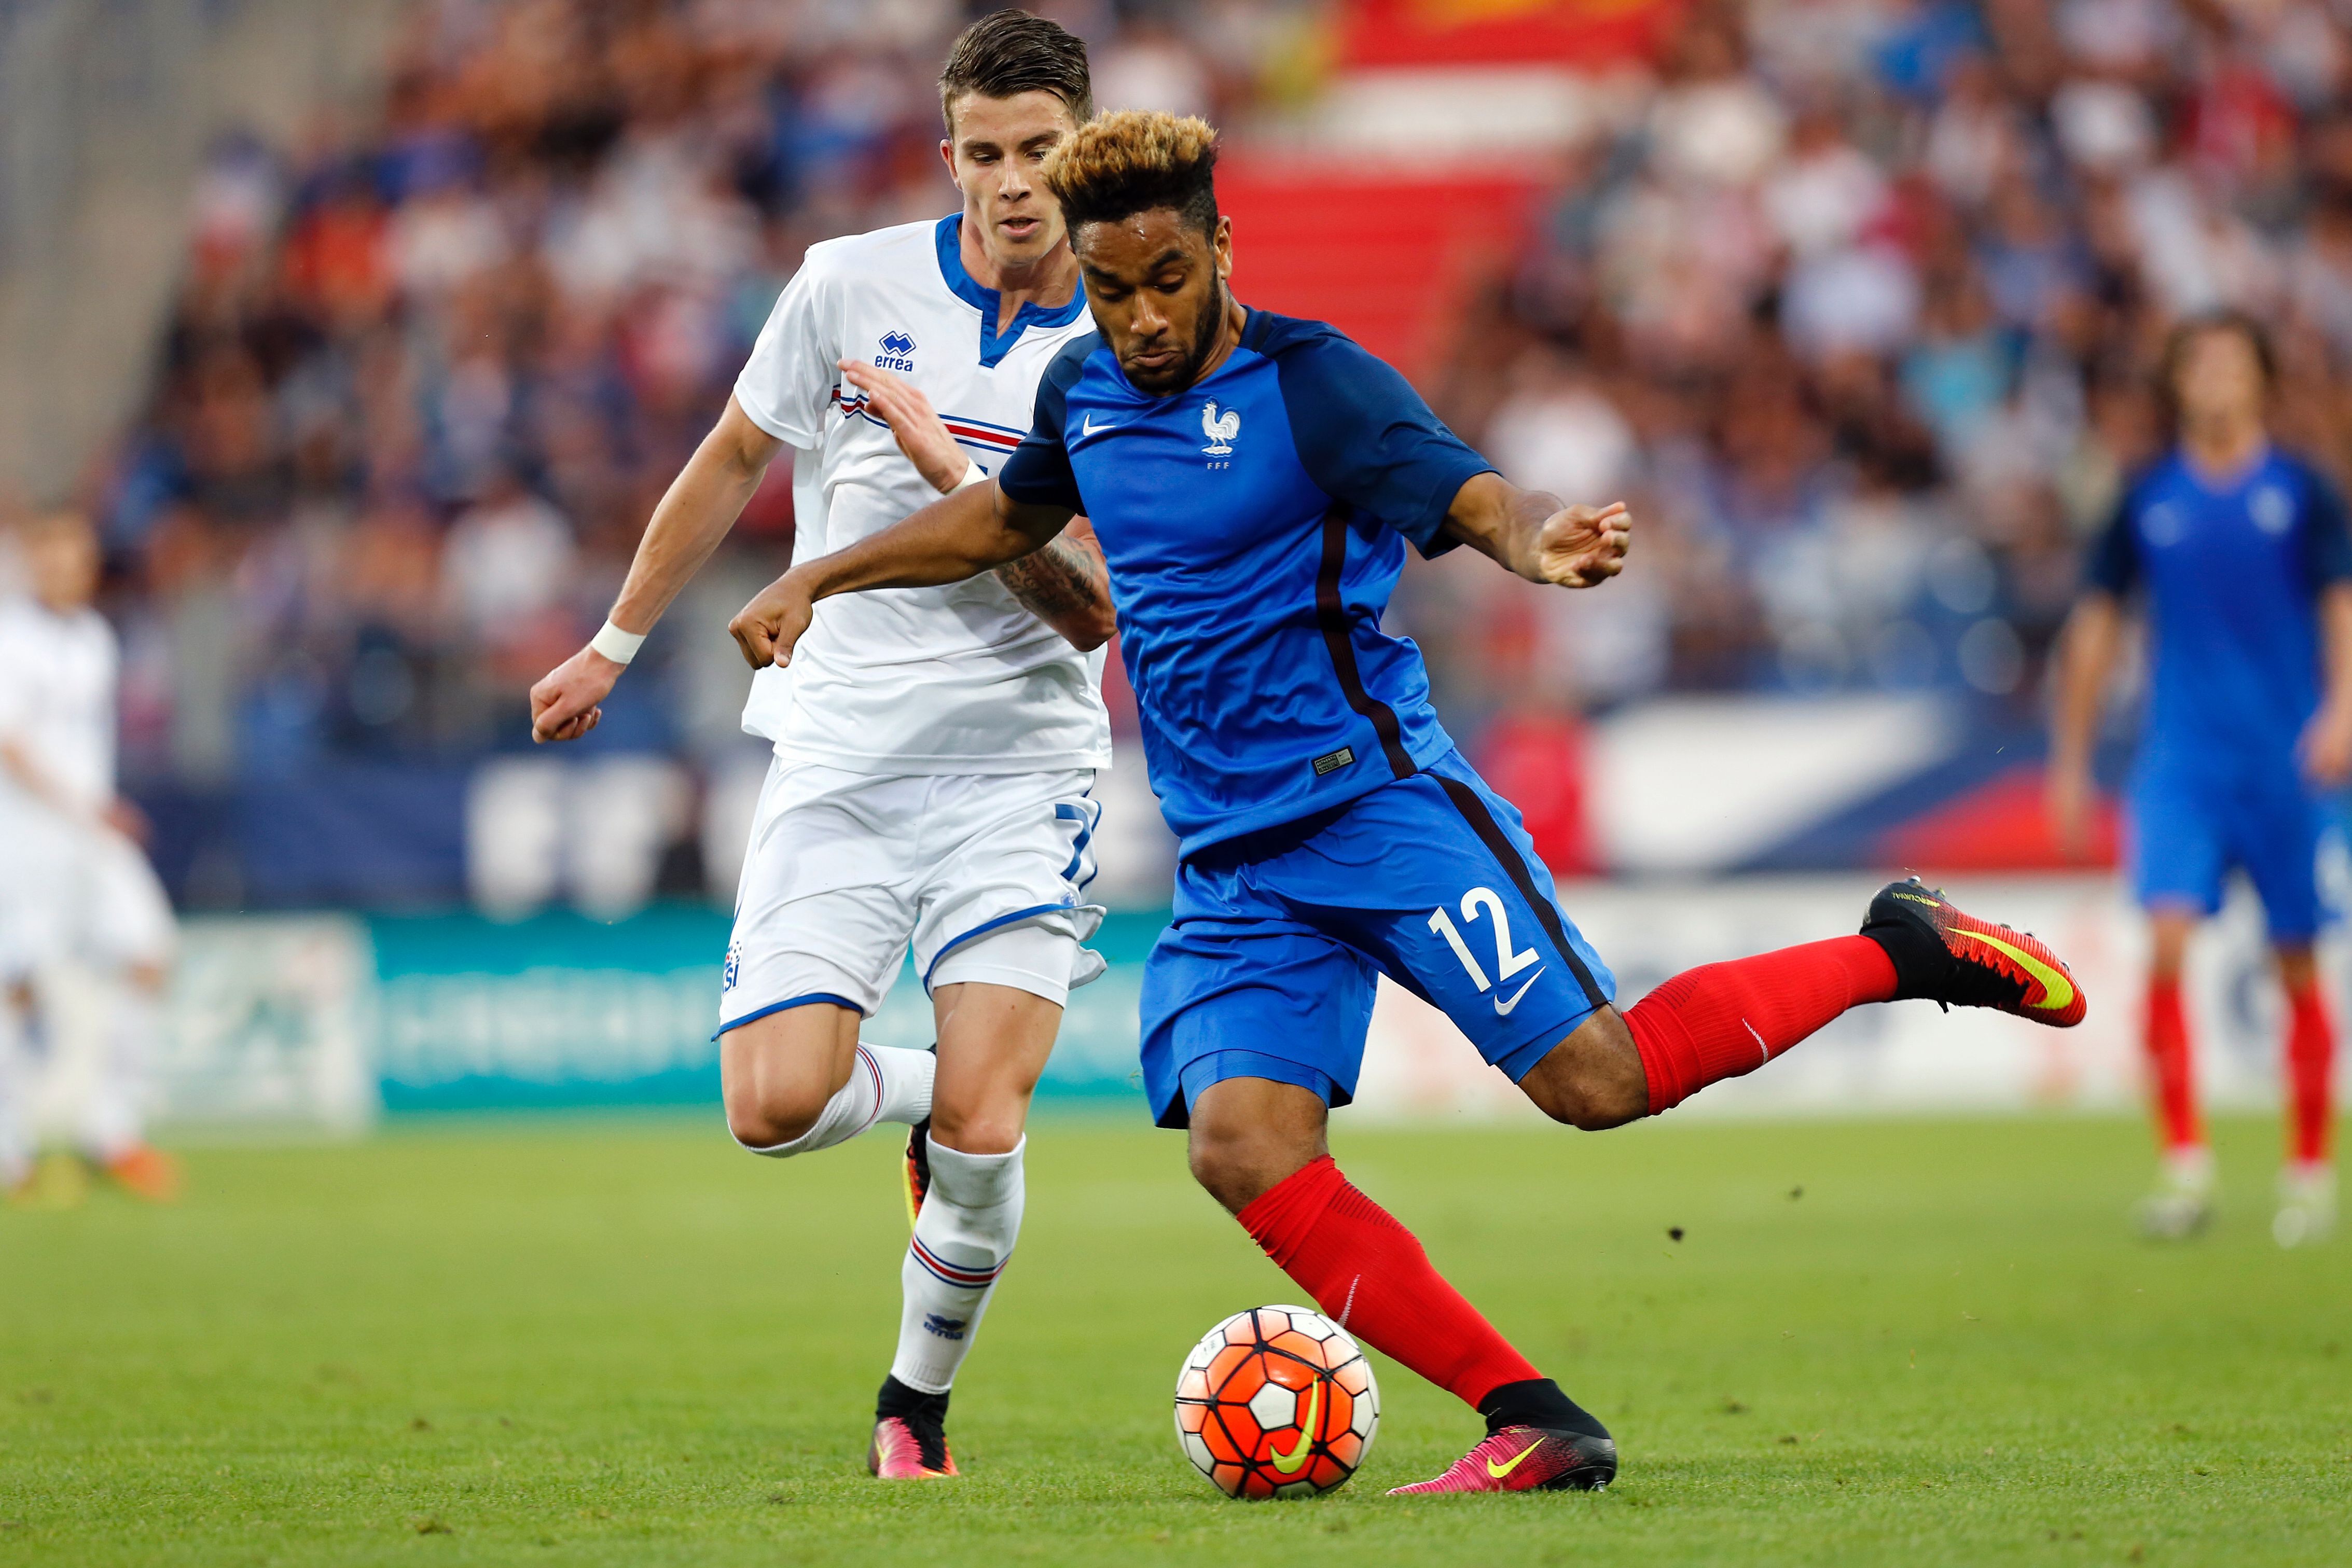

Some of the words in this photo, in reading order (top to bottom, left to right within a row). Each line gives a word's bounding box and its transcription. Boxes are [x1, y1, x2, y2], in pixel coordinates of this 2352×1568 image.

[875, 355, 913, 372] errea
[1055, 803, 1090, 881] 7
[1427, 887, 1540, 993] 12
